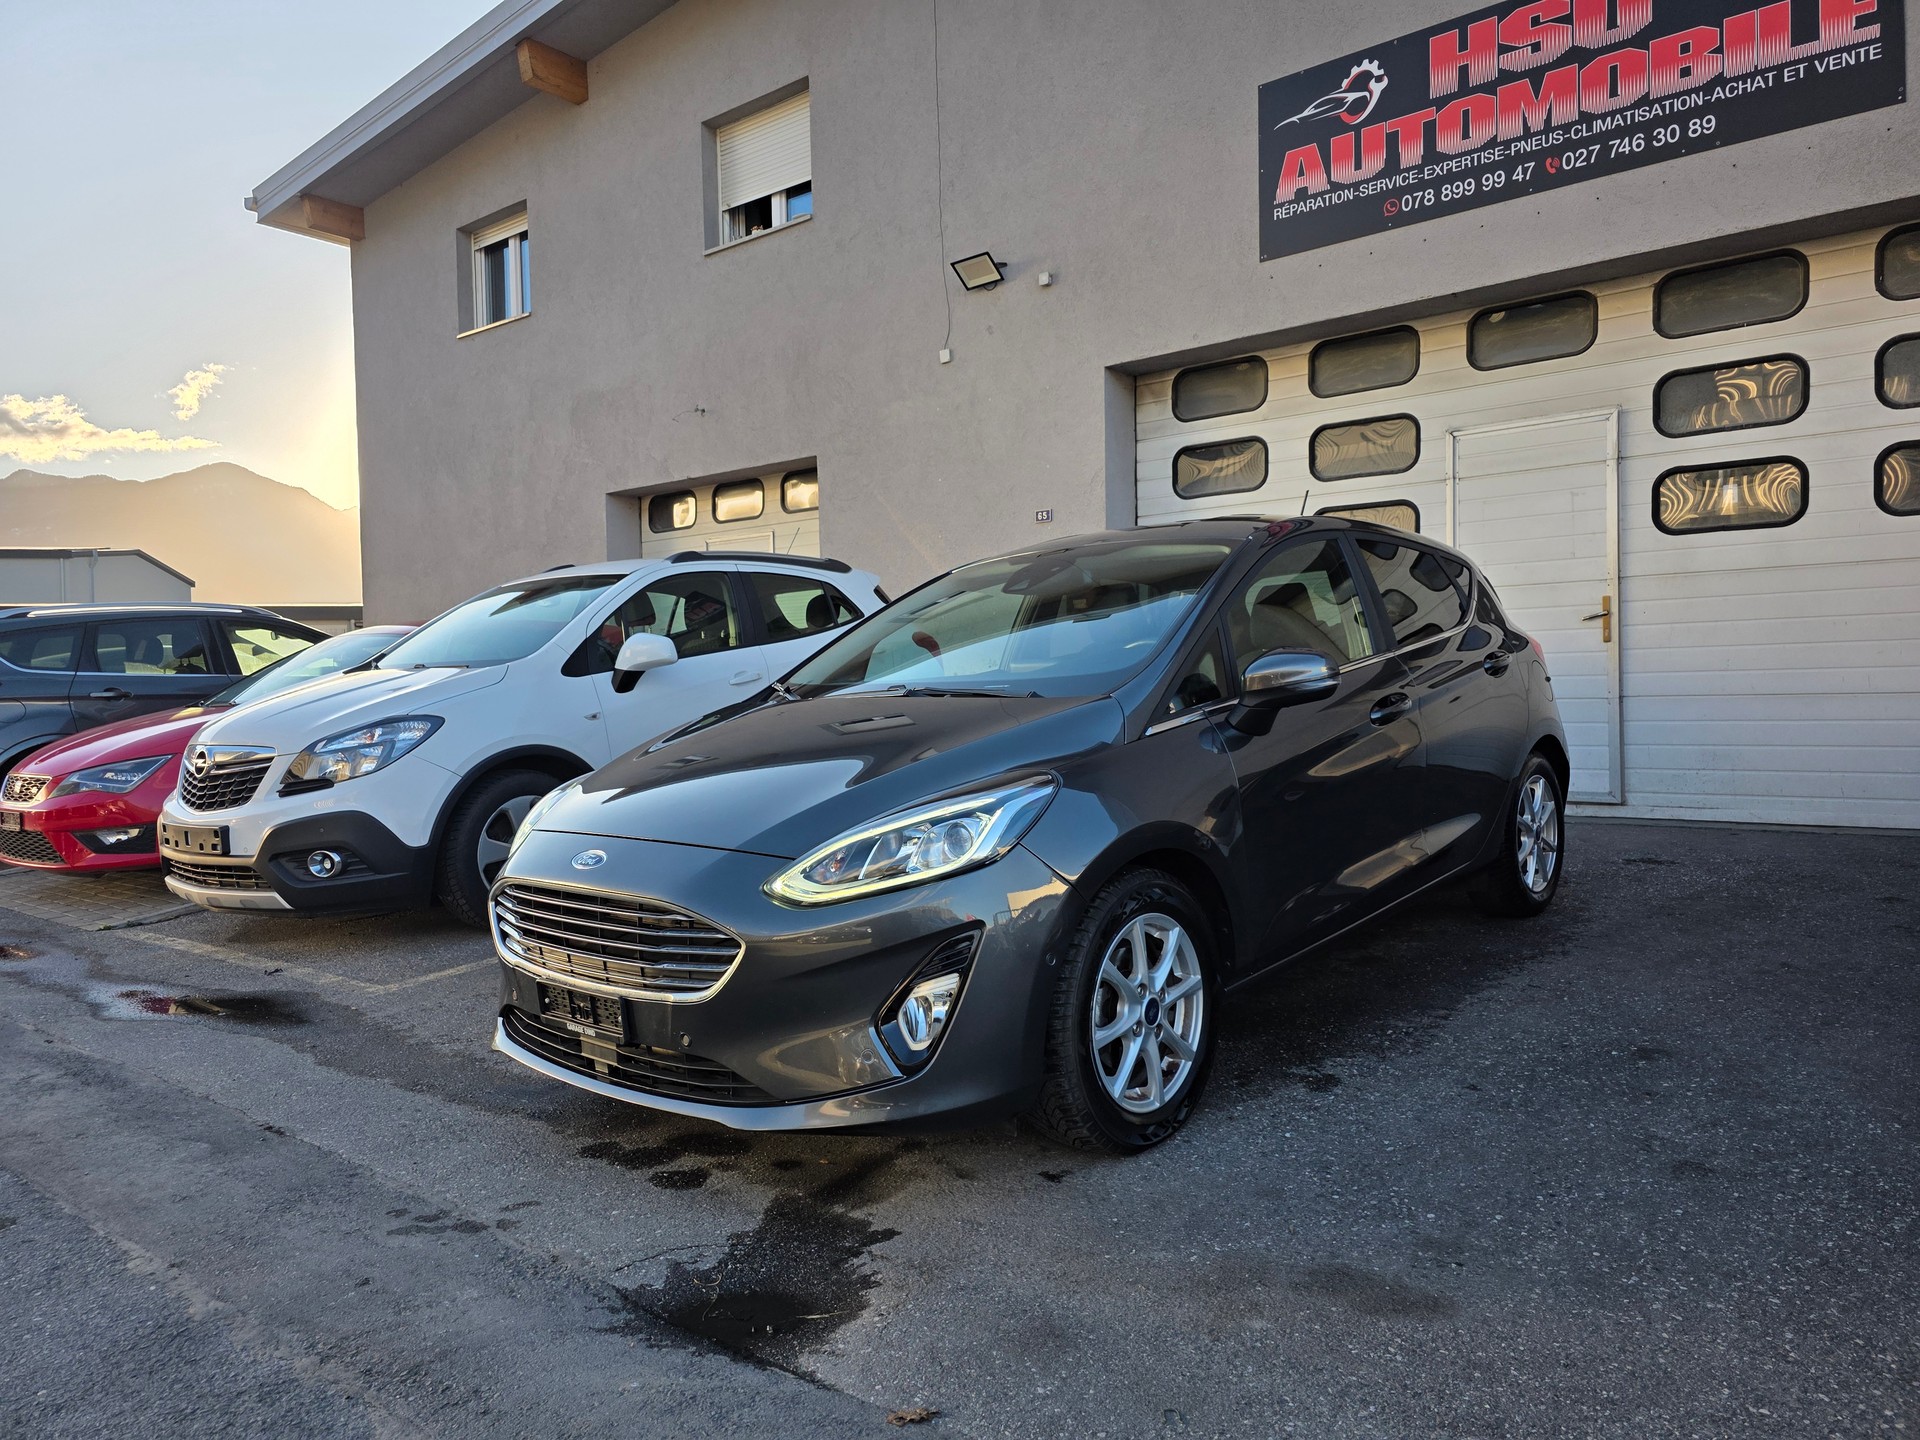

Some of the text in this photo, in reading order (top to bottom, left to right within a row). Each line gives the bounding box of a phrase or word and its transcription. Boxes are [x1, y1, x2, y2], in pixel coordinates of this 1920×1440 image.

[1783, 62, 1808, 83] ET
[1814, 43, 1883, 74] VENTE
[1273, 0, 1882, 205] AUTOMOBILE
[1561, 115, 1717, 171] 027 746 30 89
[1401, 161, 1536, 212] 078 899 99 47
[1037, 511, 1047, 520] 65
